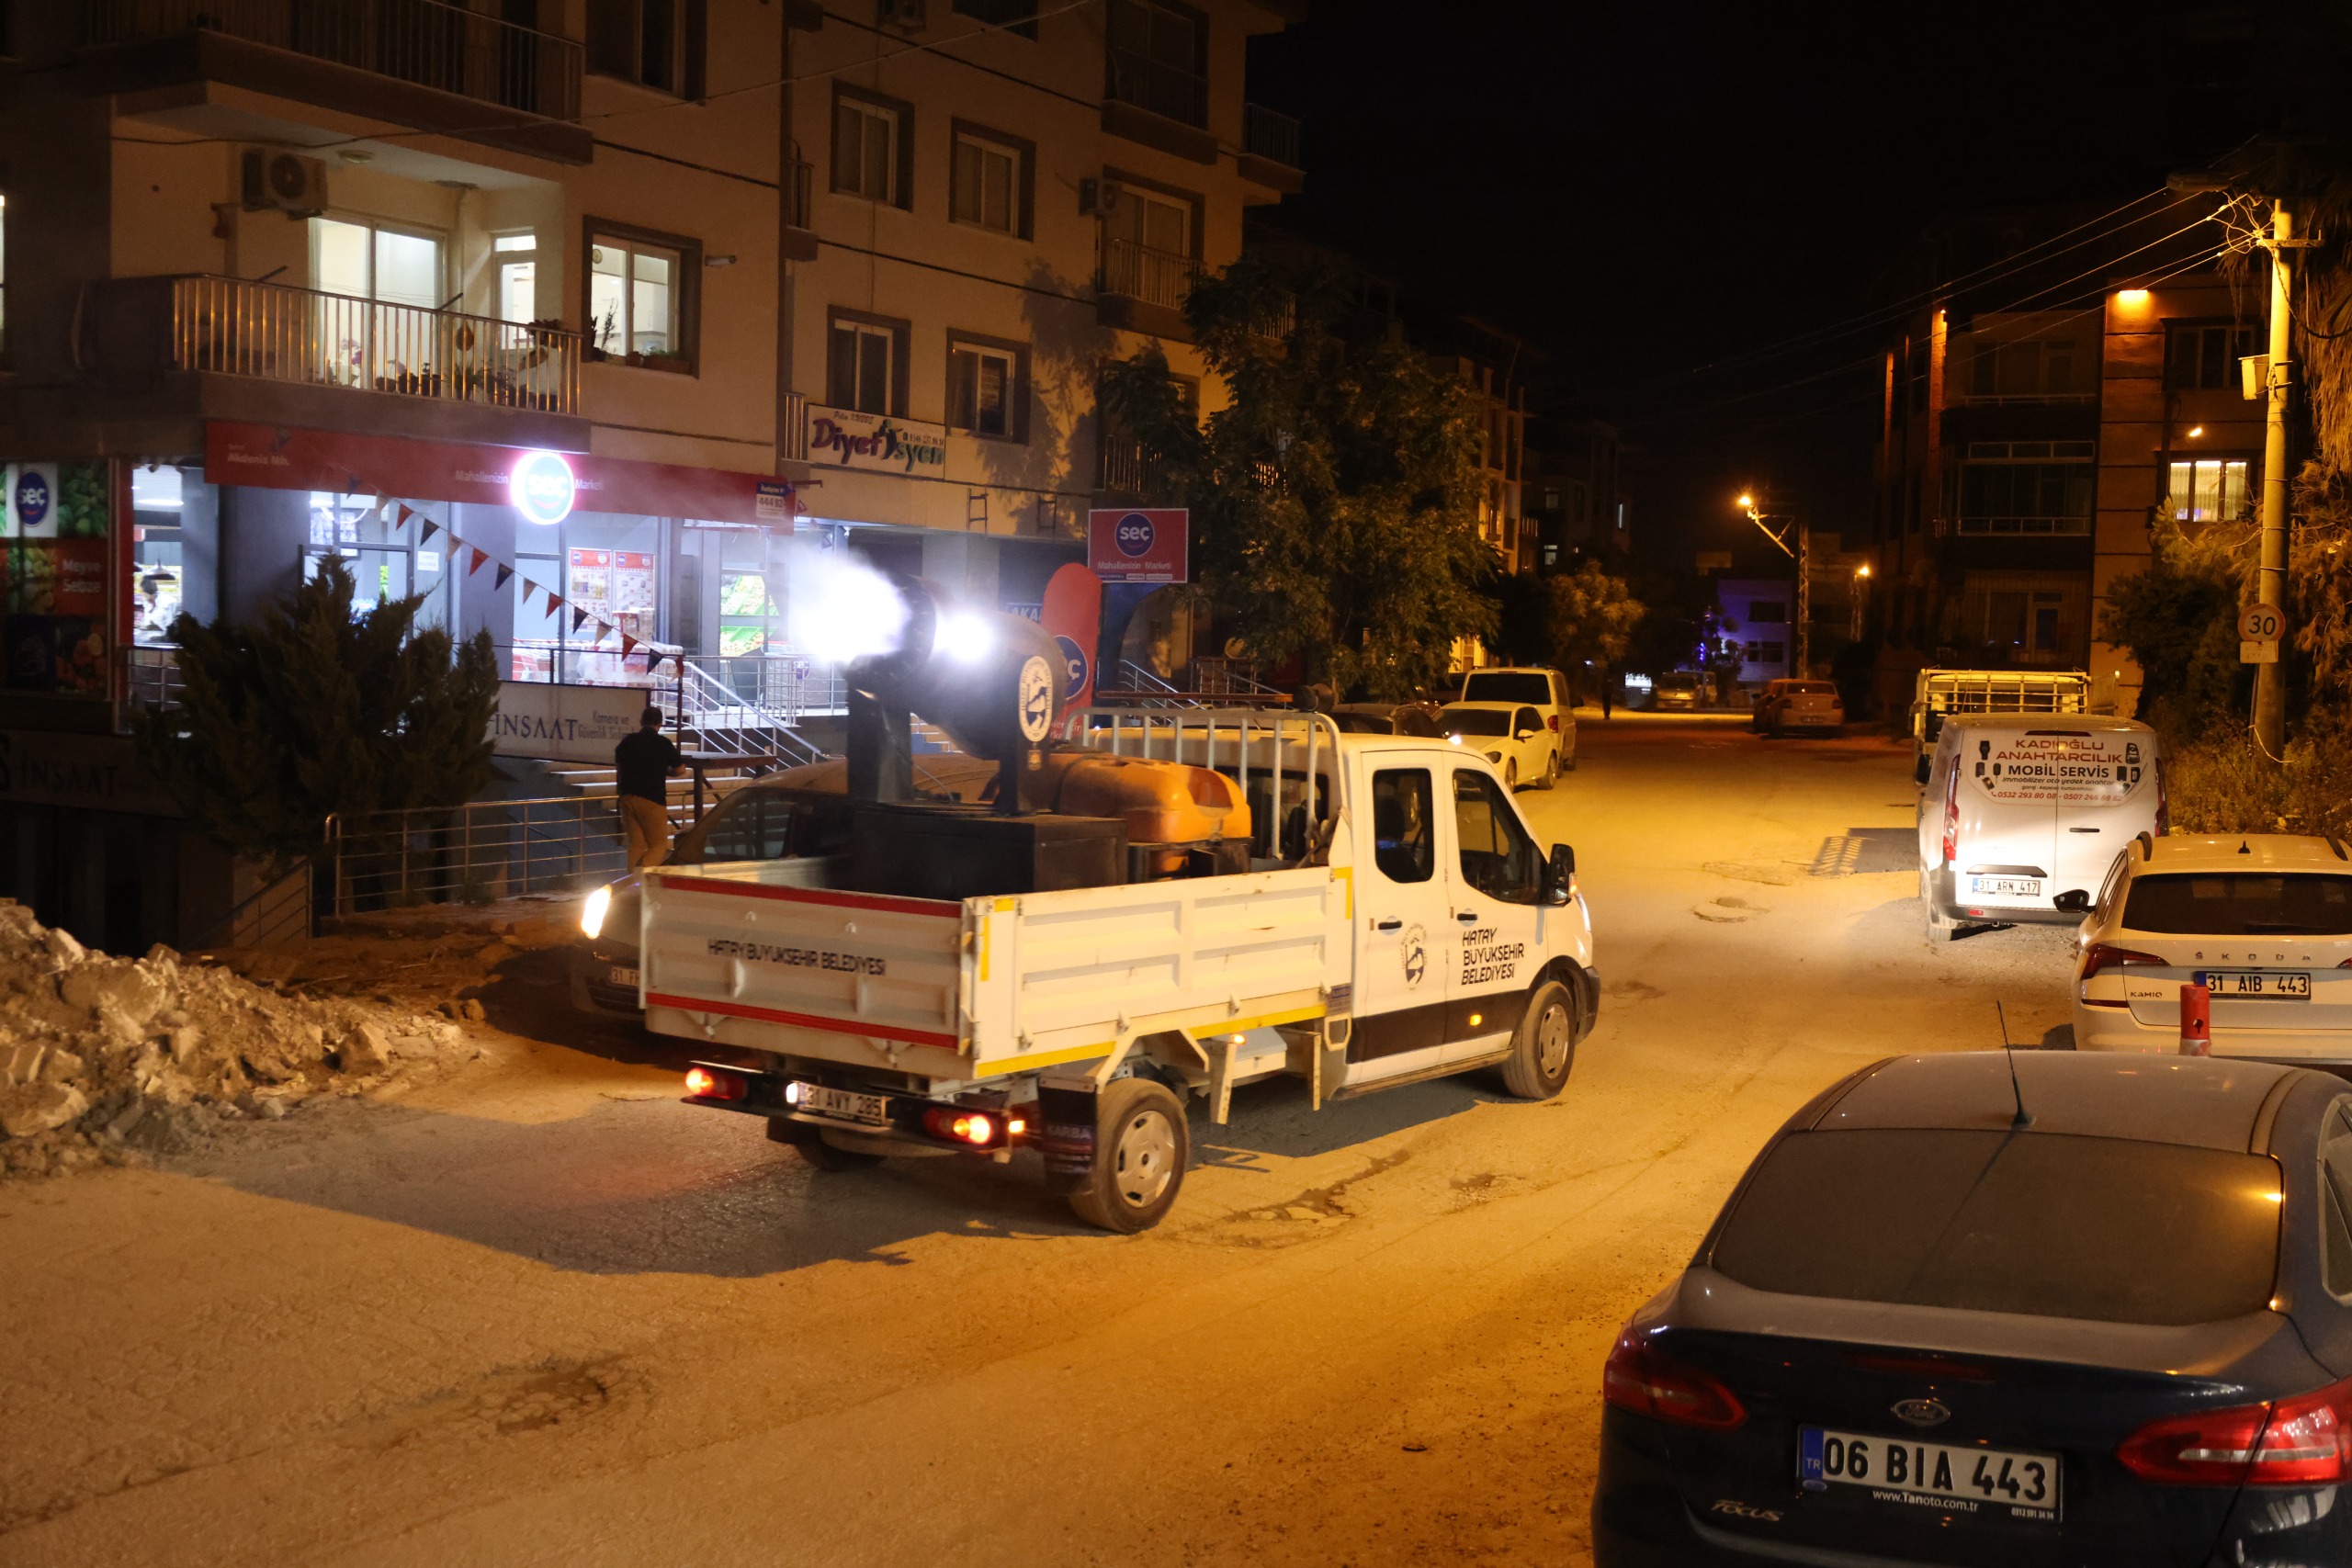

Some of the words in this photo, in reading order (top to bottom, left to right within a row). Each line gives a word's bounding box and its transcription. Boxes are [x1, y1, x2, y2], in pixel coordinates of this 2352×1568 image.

[455, 469, 509, 484] Mahallenizin
[528, 474, 568, 498] seç
[1119, 526, 1149, 541] seç
[1097, 560, 1141, 570] Mahallenizin
[1144, 560, 1171, 570] Marketi
[2248, 615, 2276, 636] 30
[2016, 739, 2104, 750] KADIOĞLU
[1996, 751, 2122, 763] ANAHTARCILIK
[2008, 763, 2056, 776] MOBİL
[2060, 764, 2109, 778] SERVİS
[1979, 880, 1990, 890] 31
[1996, 881, 2014, 892] ARN
[2020, 882, 2038, 893] 417
[1462, 928, 1497, 947] HATAY
[1464, 943, 1524, 966] BÜYÜKŞEHİR
[613, 968, 623, 983] 31
[1461, 963, 1515, 986] BELEDİYESİ
[2208, 975, 2223, 992] 31
[2238, 976, 2263, 992] AIB
[2277, 976, 2307, 993] 443
[1805, 1457, 1821, 1470] TR
[1824, 1437, 1869, 1479] 06
[1886, 1443, 1953, 1492] BIA
[1972, 1455, 2046, 1502] 443
[1872, 1489, 1979, 1513] www.Tanoto.com.tr
